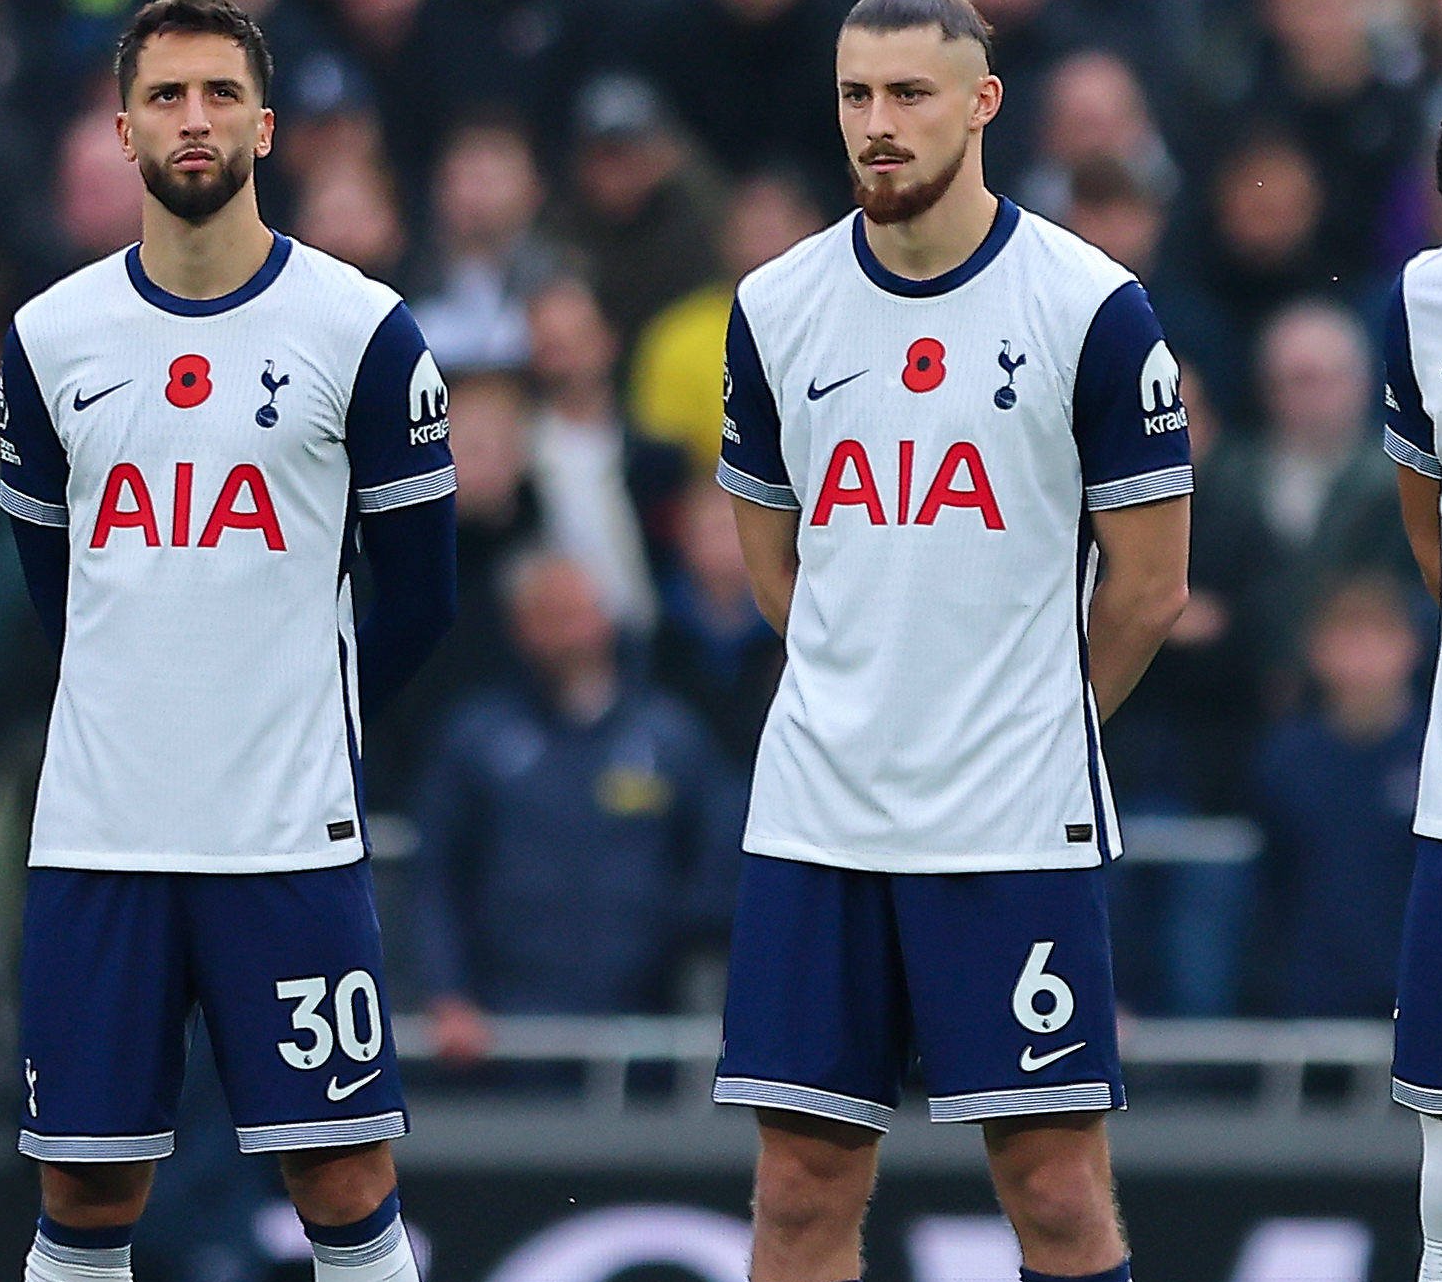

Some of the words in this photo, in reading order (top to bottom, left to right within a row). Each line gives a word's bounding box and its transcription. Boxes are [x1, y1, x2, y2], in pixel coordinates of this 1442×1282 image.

[92, 463, 285, 550] AIA
[812, 440, 1005, 529] AIA
[277, 971, 381, 1069] 30
[1013, 942, 1073, 1032] 6
